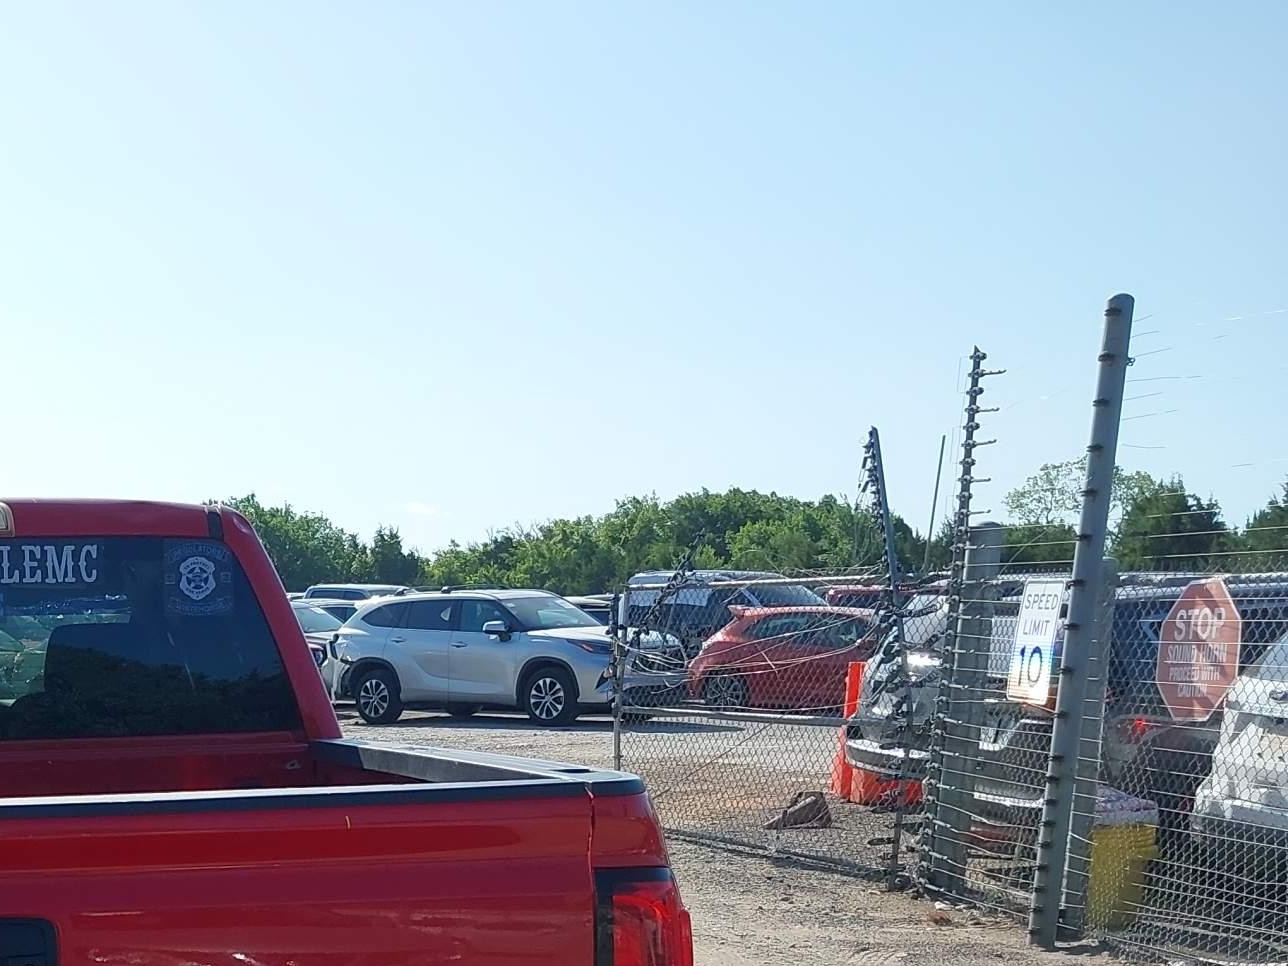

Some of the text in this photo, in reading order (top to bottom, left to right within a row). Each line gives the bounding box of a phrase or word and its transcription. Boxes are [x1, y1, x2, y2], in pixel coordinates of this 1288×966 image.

[0, 544, 98, 584] LEMC
[1024, 593, 1059, 610] SPEED
[1022, 619, 1051, 637] LIMIT
[1174, 607, 1226, 641] STOP
[1167, 643, 1228, 662] SOUND HORN
[1017, 645, 1043, 687] 10
[1169, 666, 1221, 681] PROCEED WITH
[1177, 684, 1208, 698] CAUTION
